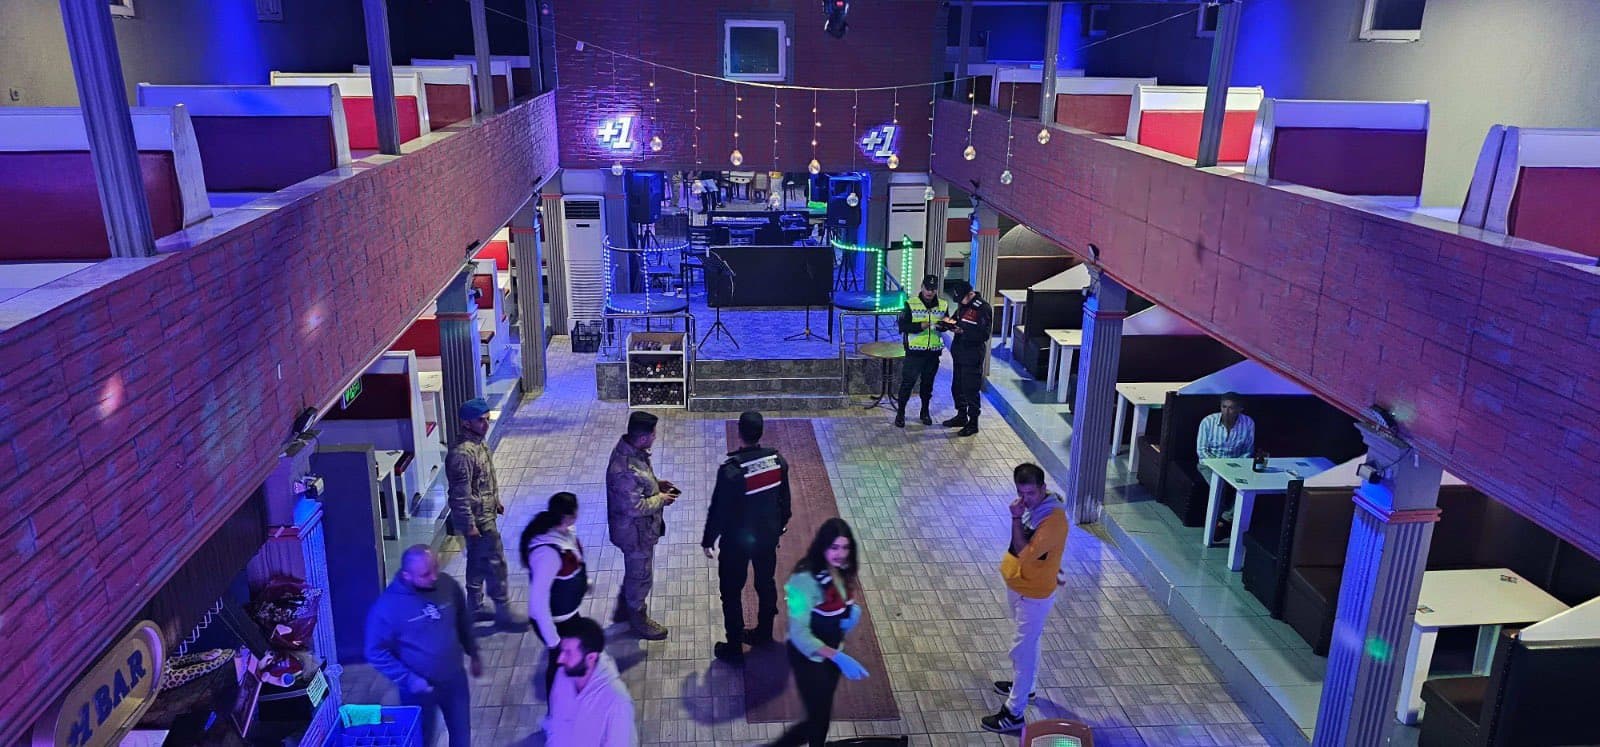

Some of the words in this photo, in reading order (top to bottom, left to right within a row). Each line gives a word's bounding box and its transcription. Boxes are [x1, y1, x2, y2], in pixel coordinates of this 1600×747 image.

[597, 116, 632, 149] +1
[862, 126, 895, 157] +1
[94, 650, 146, 726] BAR
